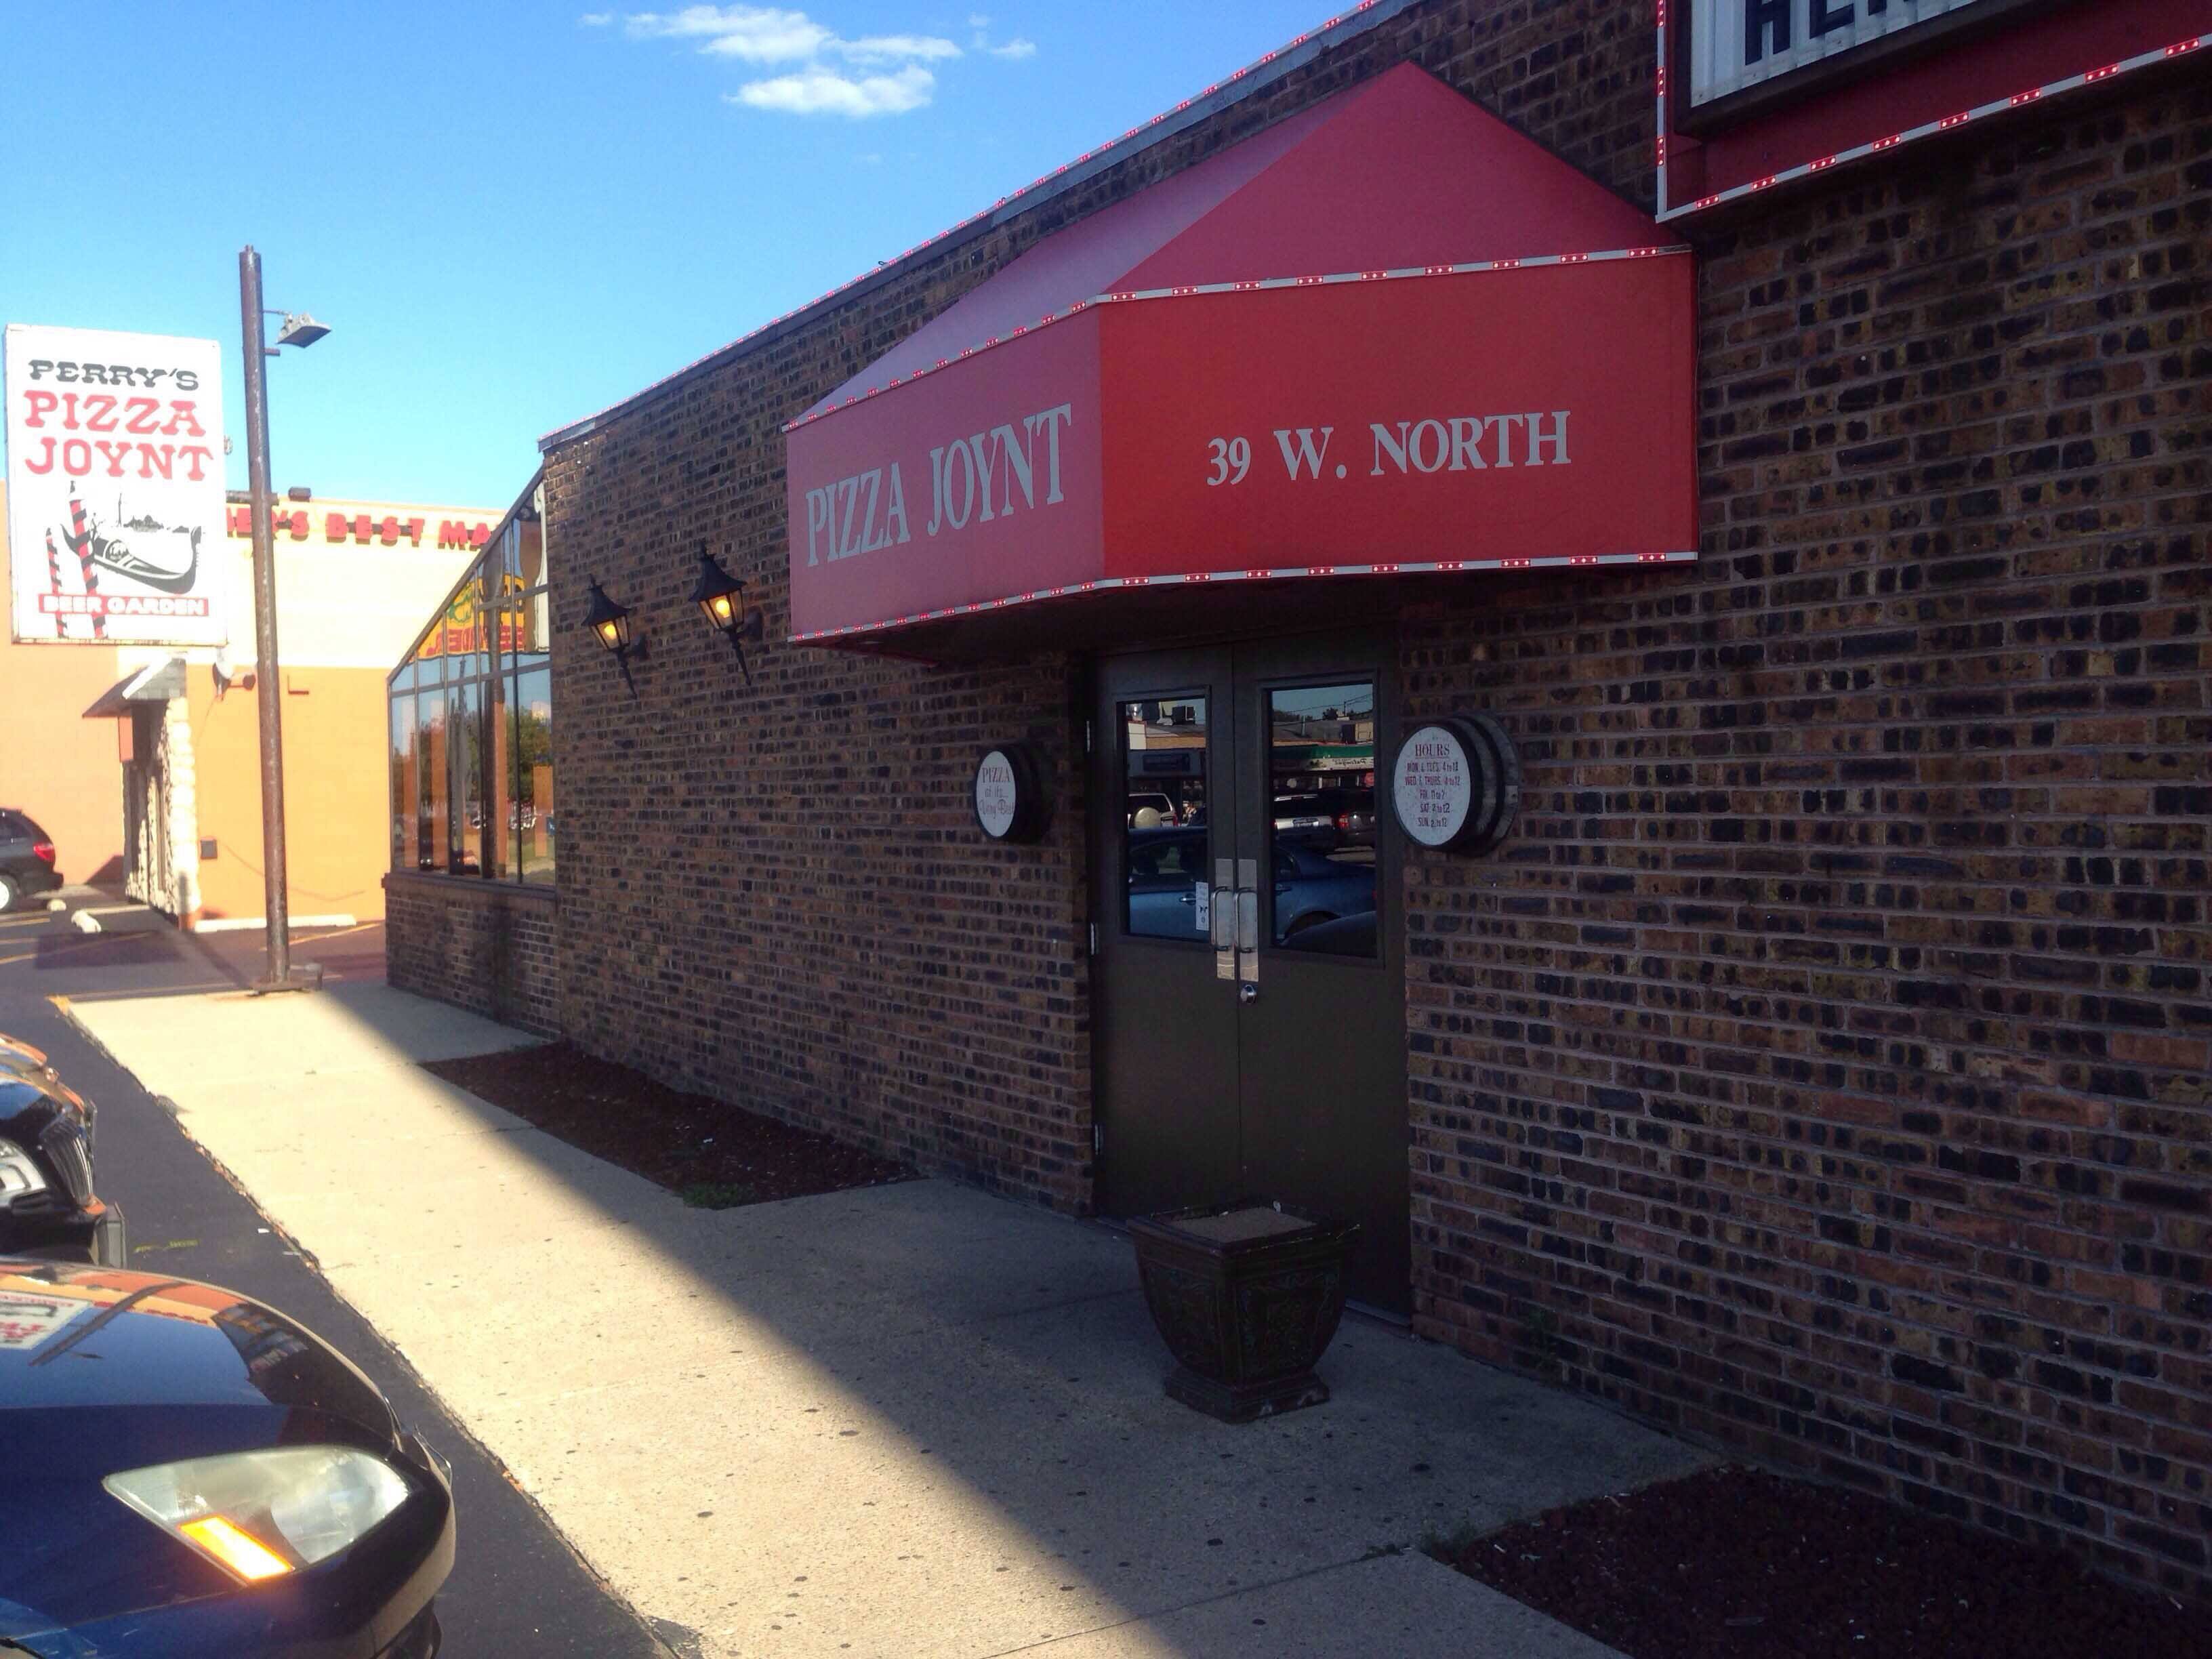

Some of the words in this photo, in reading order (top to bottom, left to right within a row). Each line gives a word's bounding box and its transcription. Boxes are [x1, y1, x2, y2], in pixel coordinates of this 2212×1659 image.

[28, 359, 199, 391] PERRY'S
[23, 390, 206, 437] PIZZA
[24, 436, 214, 481] JOYNT
[1207, 436, 1251, 486] 39
[1273, 426, 1347, 481] W.
[1370, 410, 1572, 476] NORTH
[805, 462, 912, 568] PIZZA
[927, 403, 1072, 537] JOYNT
[325, 513, 425, 546] BEST
[438, 520, 499, 550] MA
[43, 595, 102, 613] BEER
[107, 596, 206, 616] GARDEN
[1415, 743, 1450, 756] HOURS
[982, 766, 1010, 783] PIZZA
